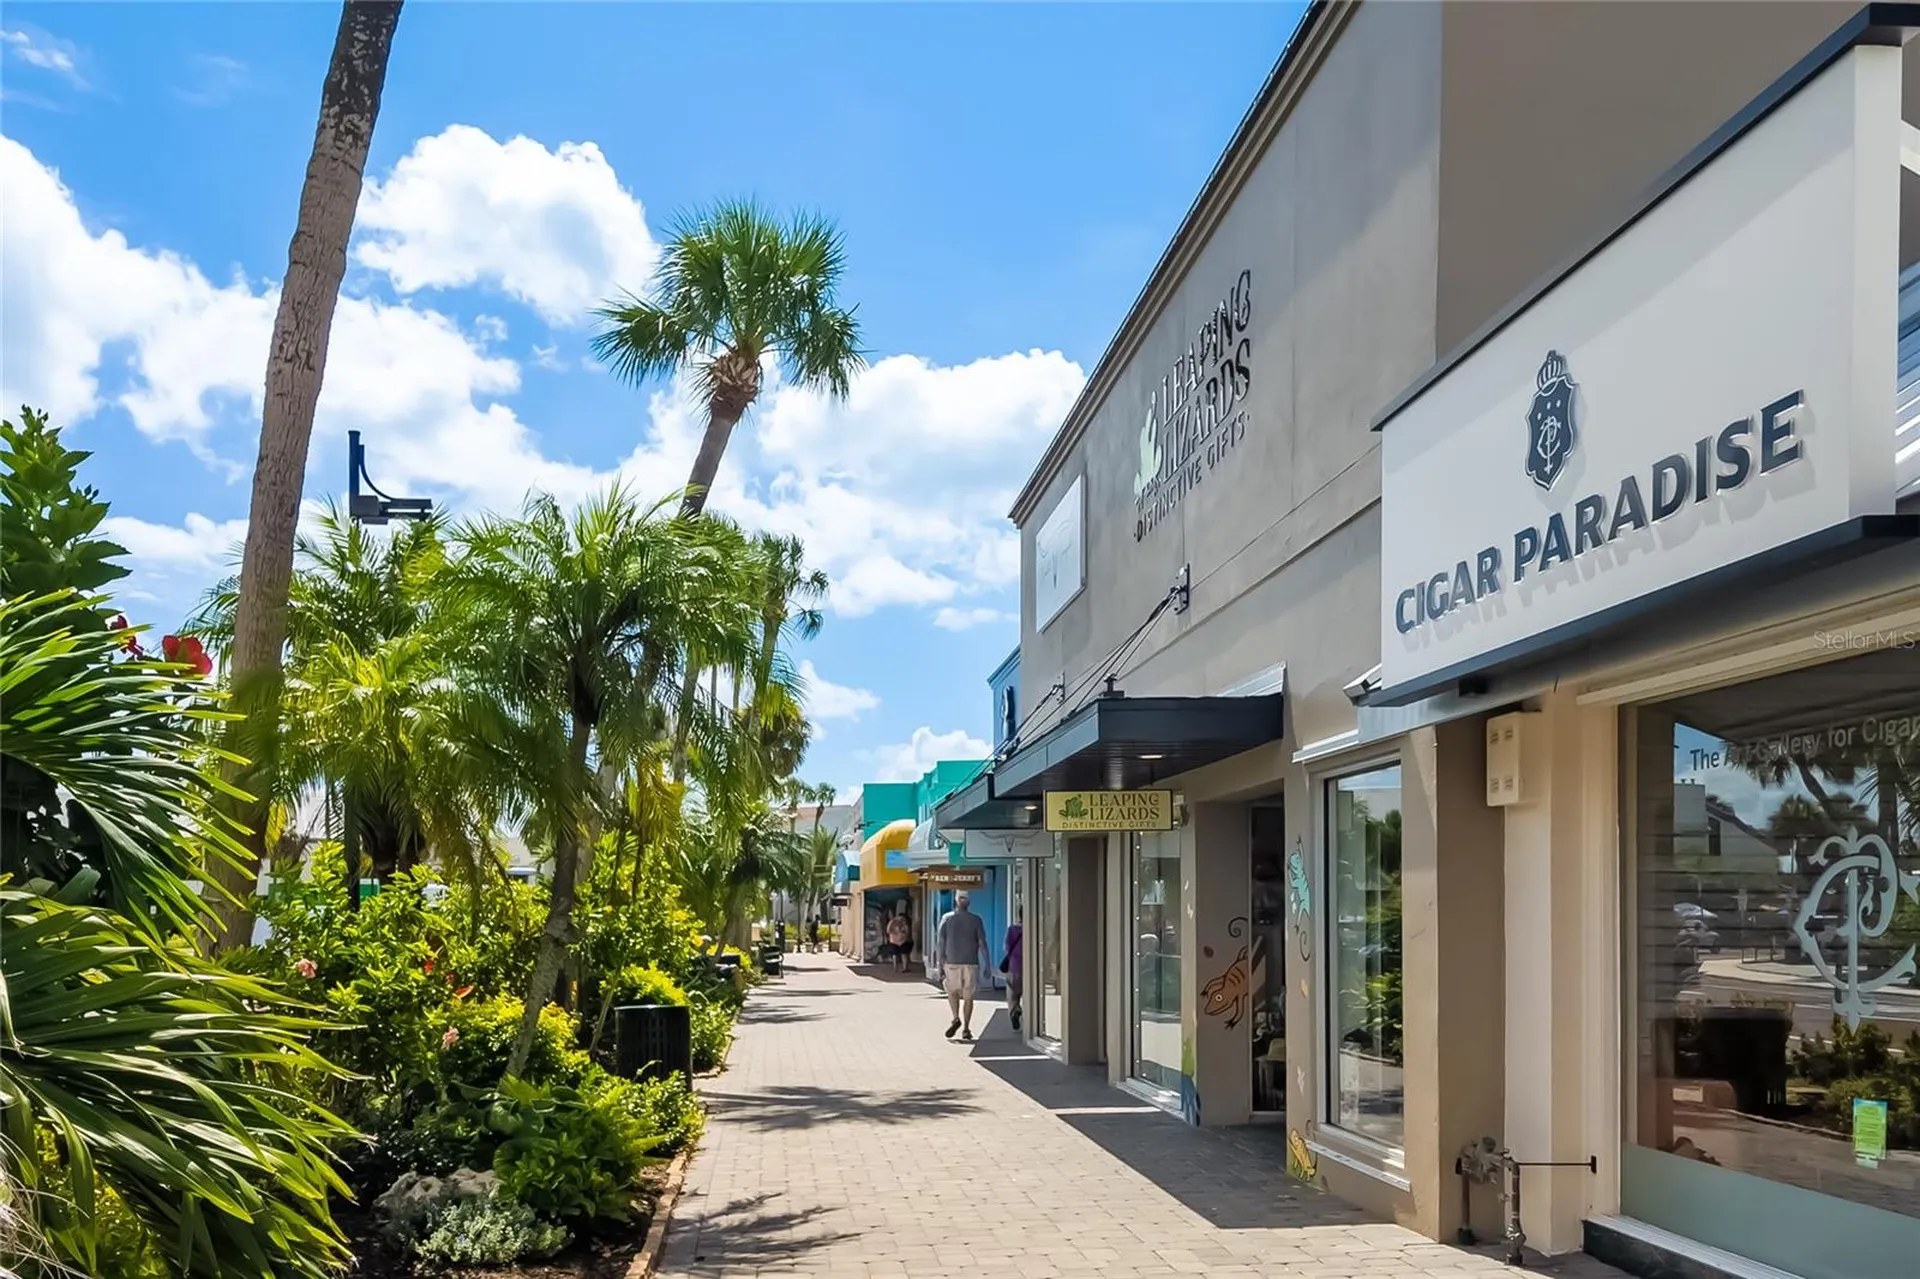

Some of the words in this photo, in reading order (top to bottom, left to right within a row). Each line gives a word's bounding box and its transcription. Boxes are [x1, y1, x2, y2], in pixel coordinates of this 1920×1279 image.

[1162, 268, 1251, 428] LEAPING
[1162, 337, 1251, 484] LIZARDS
[1395, 545, 1503, 634] CIGAR
[1513, 388, 1805, 585] PARADISE
[1690, 748, 1720, 771] The
[1756, 733, 1822, 762] Gallery
[1828, 727, 1857, 748] for
[1089, 793, 1160, 806] LEAPING
[1089, 807, 1160, 820] LIZARDS
